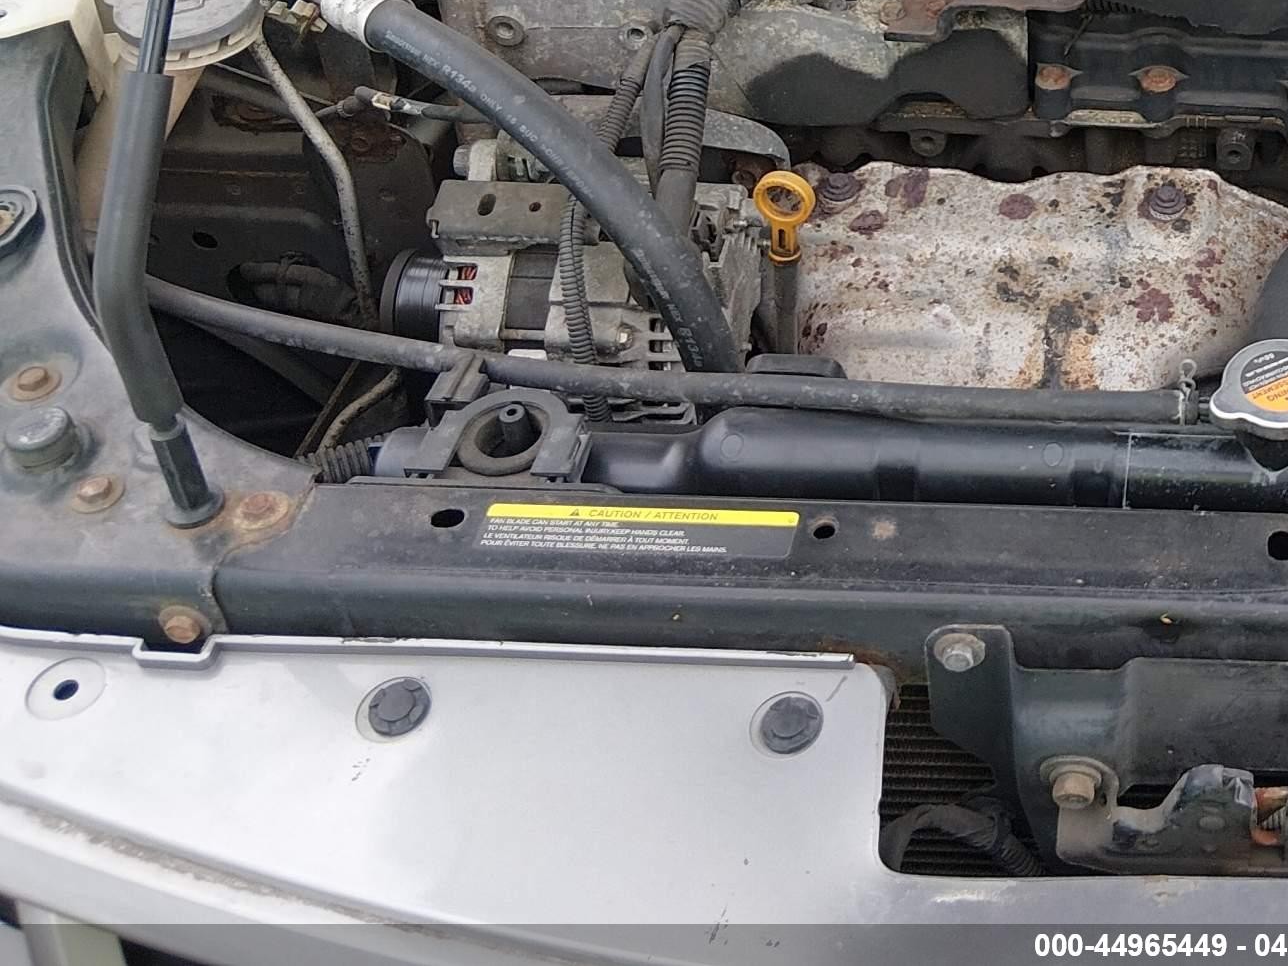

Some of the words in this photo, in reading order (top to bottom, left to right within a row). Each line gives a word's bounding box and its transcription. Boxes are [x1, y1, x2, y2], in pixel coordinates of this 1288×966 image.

[479, 93, 503, 112] ONLY
[589, 508, 642, 518] CAUTION
[654, 511, 719, 521] ATTENTION
[543, 526, 583, 534] PERSONAL
[639, 544, 686, 552] APPROCHER
[686, 545, 701, 553] LES
